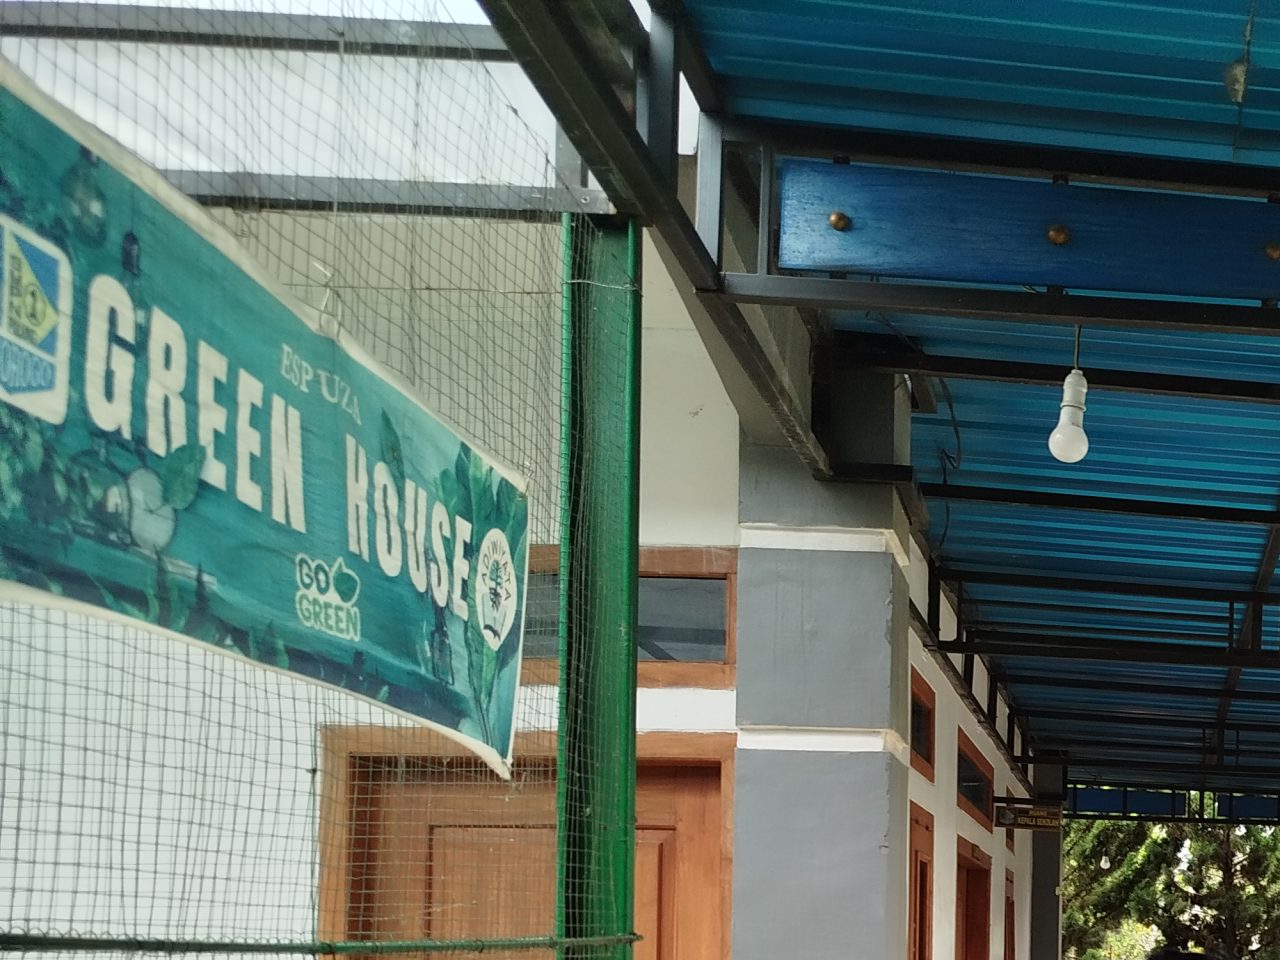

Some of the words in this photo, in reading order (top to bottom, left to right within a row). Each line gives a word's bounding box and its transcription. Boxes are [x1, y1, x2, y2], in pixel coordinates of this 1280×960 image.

[84, 273, 306, 533] GREEN
[345, 433, 473, 621] HOUSE
[297, 555, 330, 596] GO
[297, 592, 360, 640] GREEN
